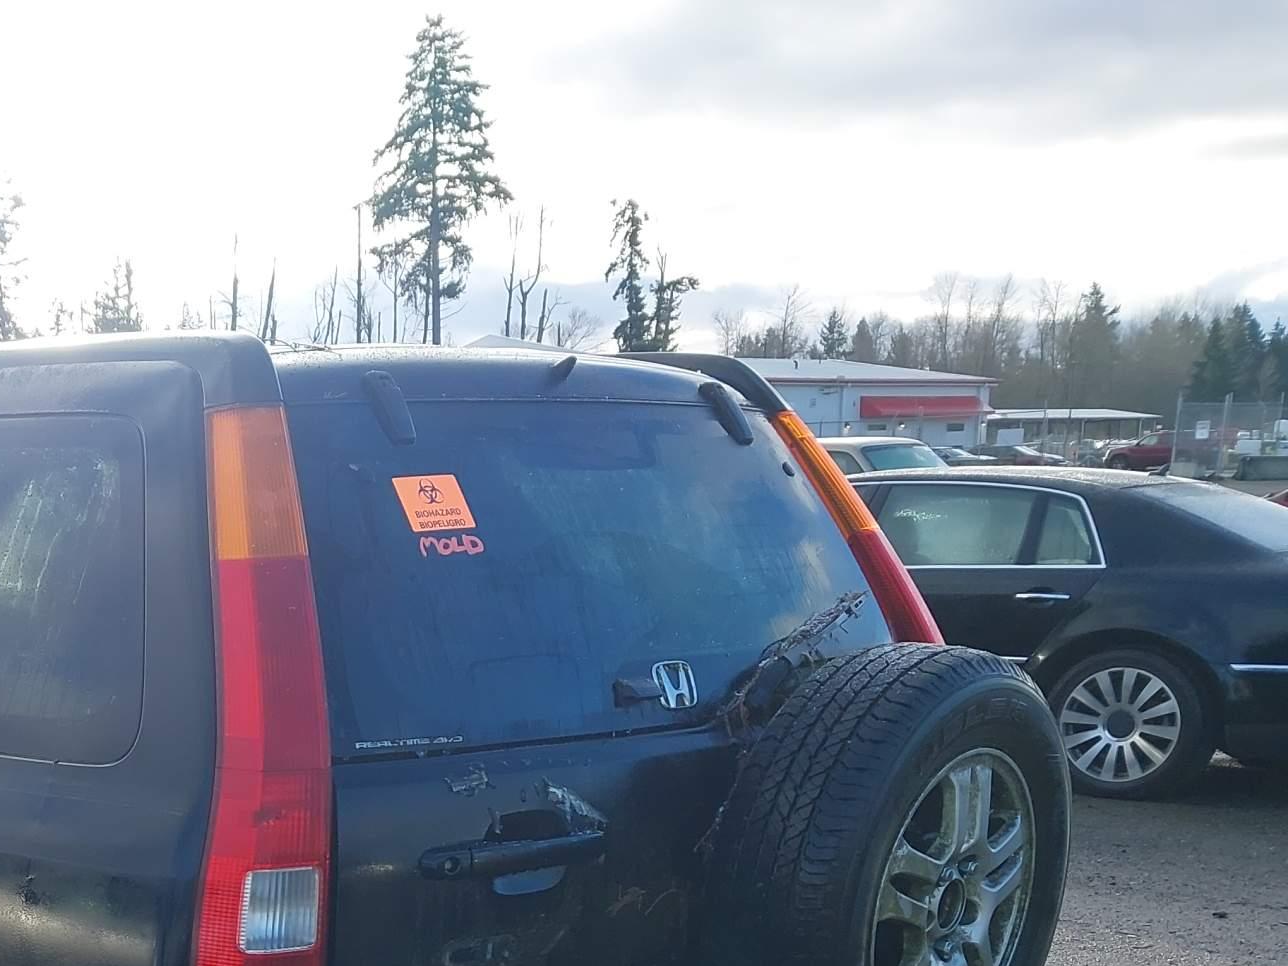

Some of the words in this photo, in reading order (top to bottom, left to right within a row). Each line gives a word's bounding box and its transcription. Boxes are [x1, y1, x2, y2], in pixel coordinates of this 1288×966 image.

[415, 508, 462, 518] BIOHAZARD
[419, 519, 466, 529] BIOPELIGRO
[420, 534, 484, 557] MOLD
